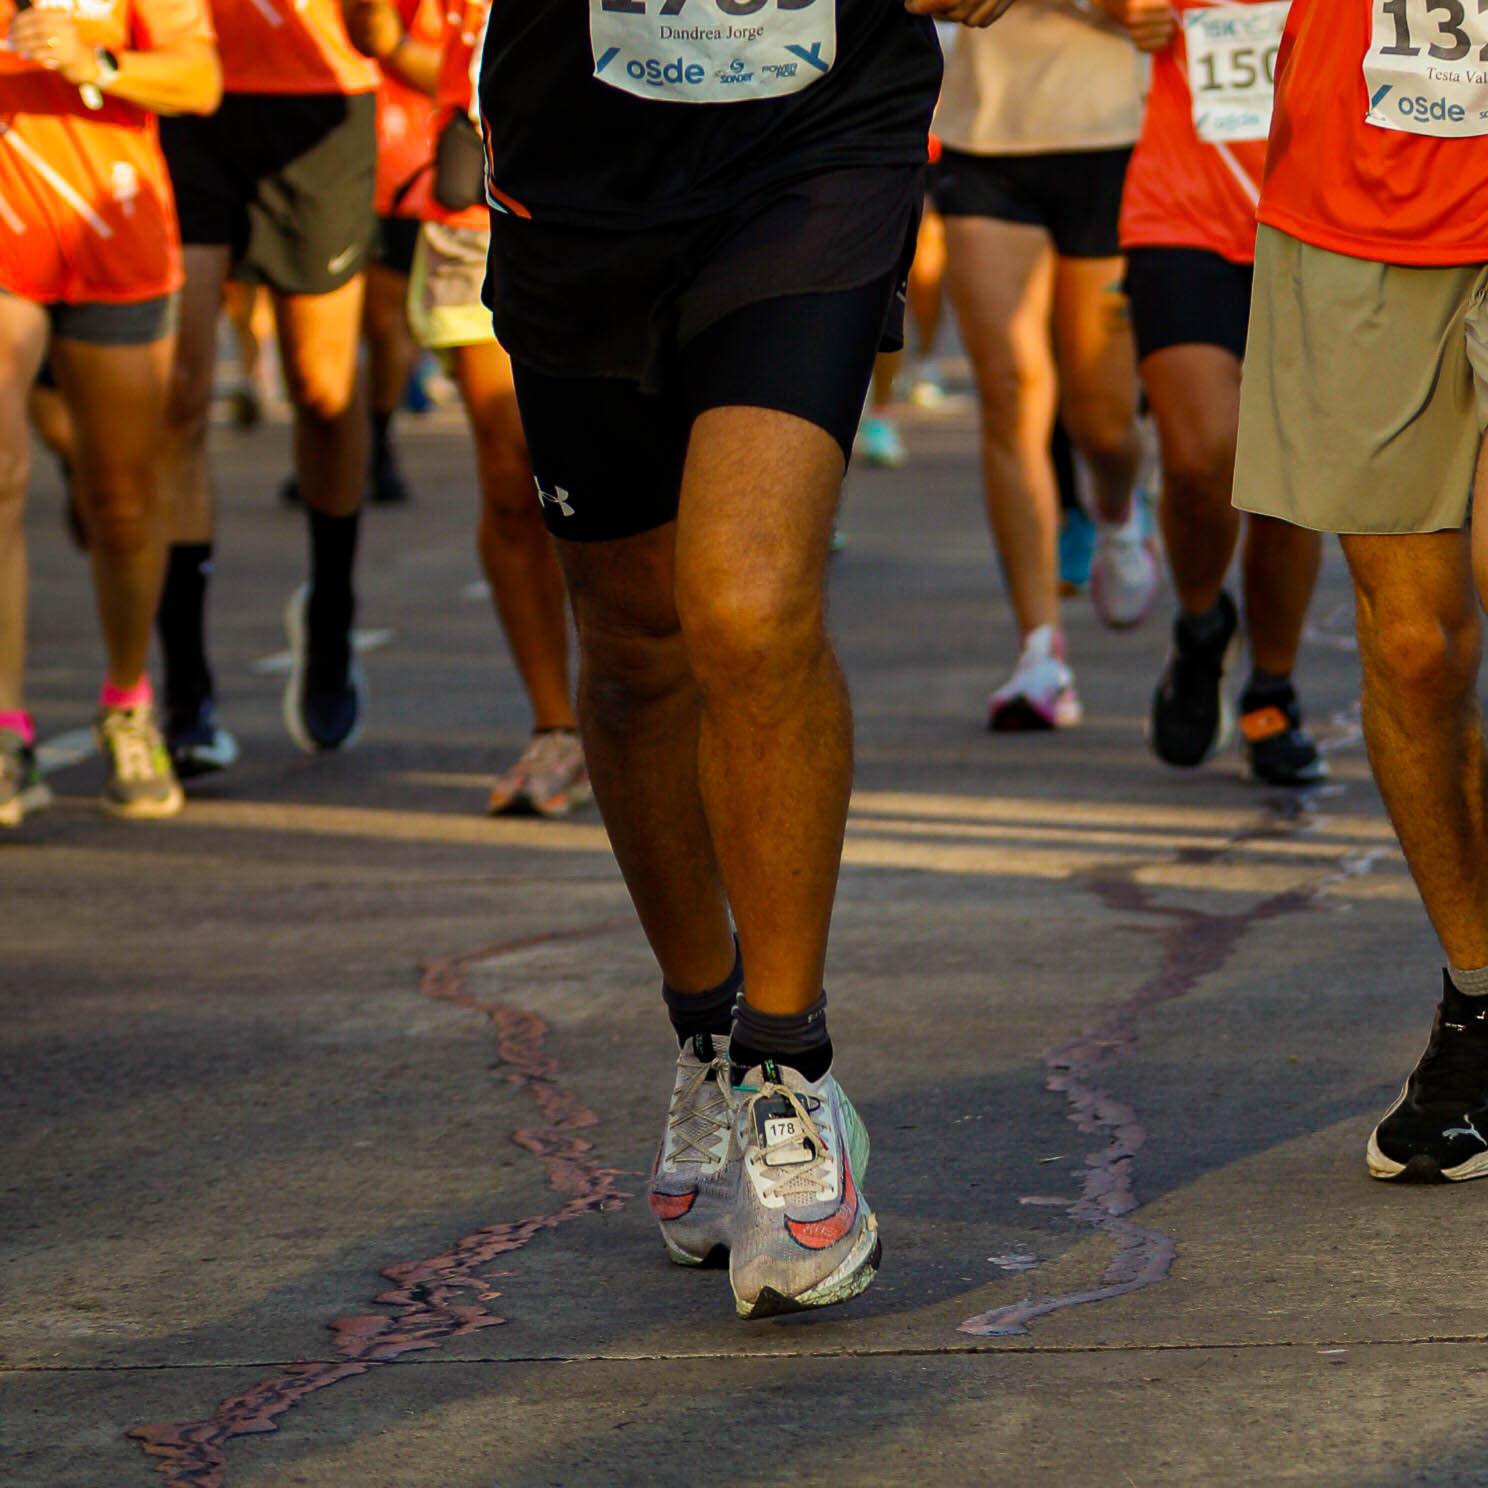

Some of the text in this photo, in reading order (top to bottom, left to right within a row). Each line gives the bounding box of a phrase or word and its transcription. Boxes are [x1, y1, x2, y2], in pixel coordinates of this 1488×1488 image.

[660, 24, 764, 41] Dandrea Jorge
[626, 56, 705, 86] osde
[1197, 45, 1279, 92] 150
[1426, 67, 1460, 82] Testa
[1398, 96, 1465, 123] osde
